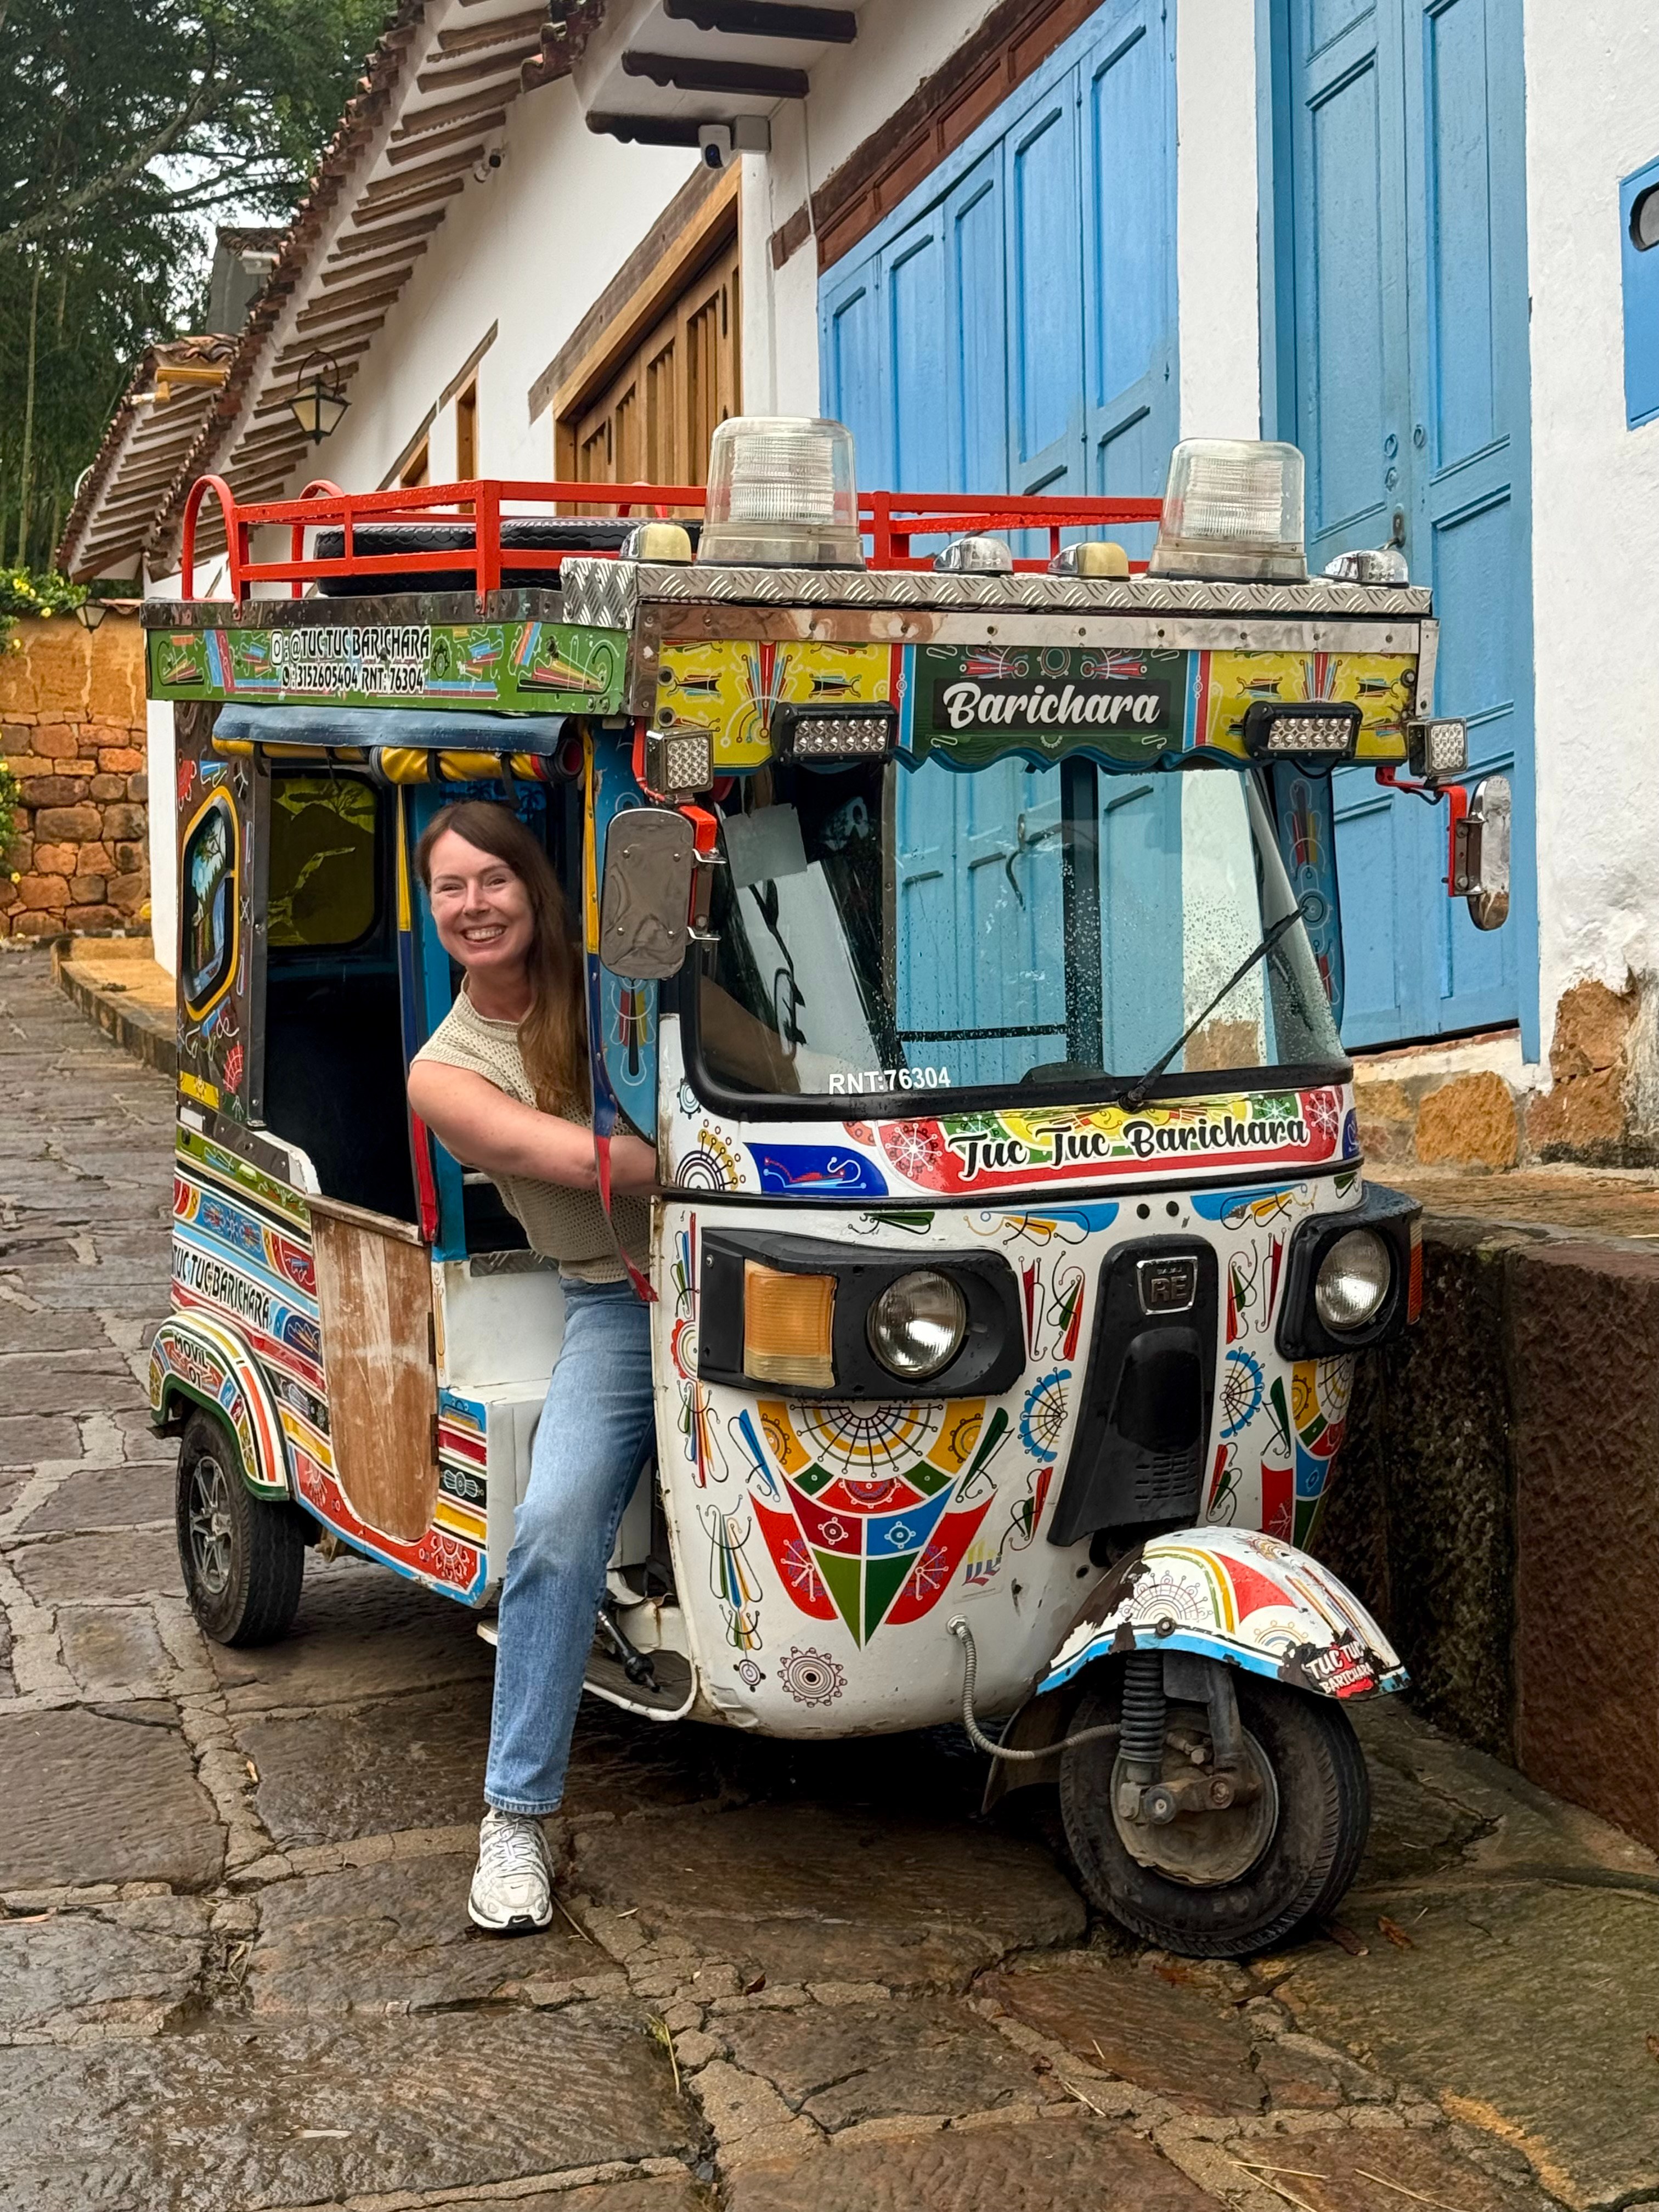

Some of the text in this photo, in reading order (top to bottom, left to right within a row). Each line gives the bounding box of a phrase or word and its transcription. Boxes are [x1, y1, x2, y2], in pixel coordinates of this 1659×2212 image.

[326, 629, 349, 656] TUC
[352, 628, 430, 659] BARICHARA
[297, 665, 358, 689] 3152605404
[390, 667, 423, 692] 76304
[943, 682, 1160, 729] Barichara
[829, 1066, 951, 1095] RNT:76304
[949, 1116, 1307, 1177] Tuc Tuc Barichara
[190, 1254, 211, 1293] TUC
[212, 1265, 269, 1330] BARICHARA
[1151, 1275, 1187, 1304] RE
[174, 1335, 208, 1369] MOVIL
[1305, 1640, 1365, 1680] TUC TUC
[1318, 1662, 1375, 1694] BARICHARA
